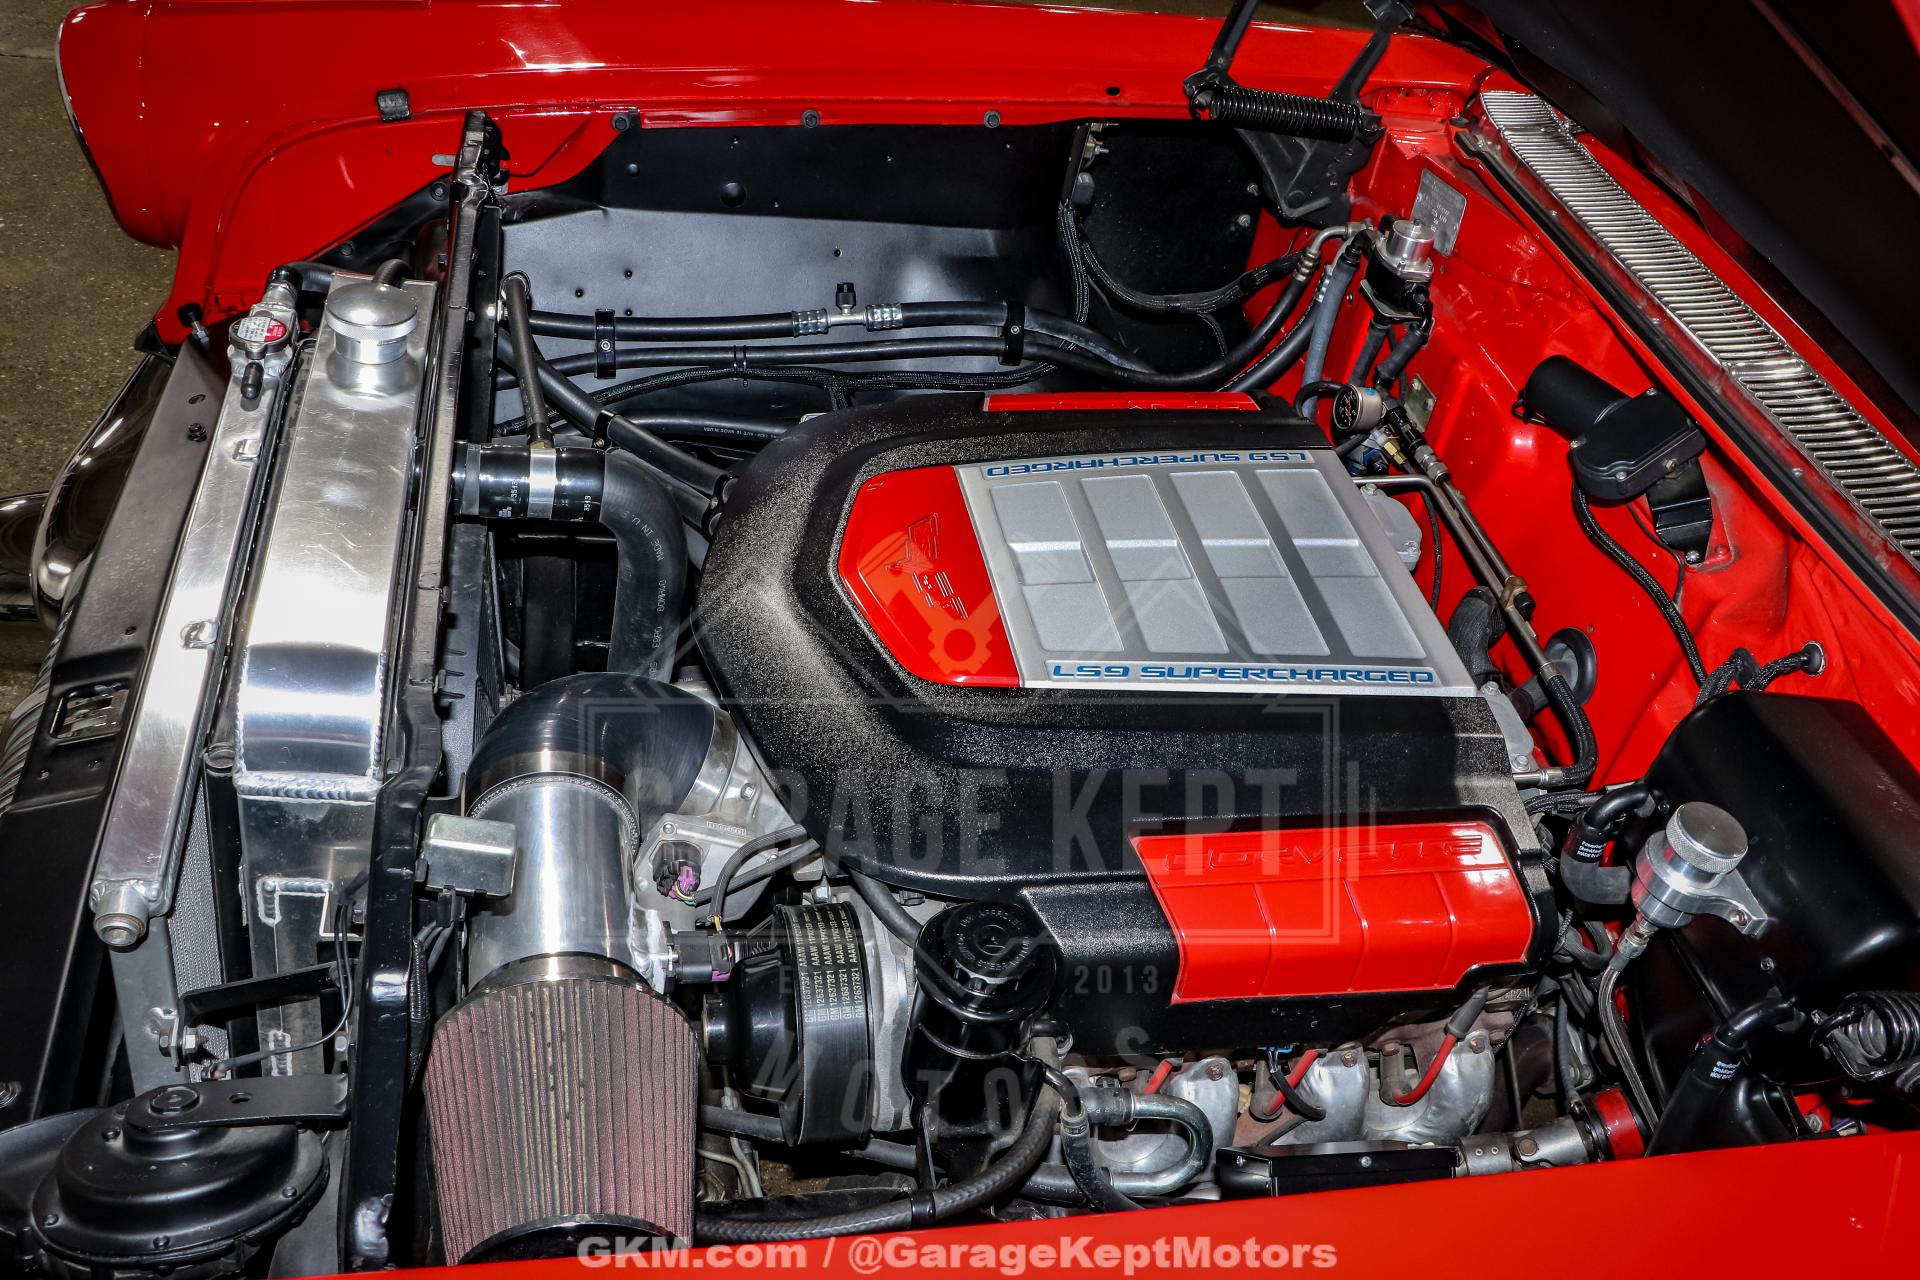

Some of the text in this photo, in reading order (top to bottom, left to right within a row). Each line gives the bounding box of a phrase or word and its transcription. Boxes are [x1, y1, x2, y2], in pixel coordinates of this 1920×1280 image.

[987, 452, 1306, 477] LS9 SUPERCHARGED
[1052, 664, 1434, 684] LS9 SUPERCHARGED
[822, 944, 833, 965] AAAW
[834, 943, 845, 964] AAAW
[847, 943, 857, 963] AAAW
[814, 971, 825, 1008] 12637321
[826, 970, 838, 1007] 12637321
[839, 969, 850, 1006] 12637321
[851, 967, 863, 1004] 12637321
